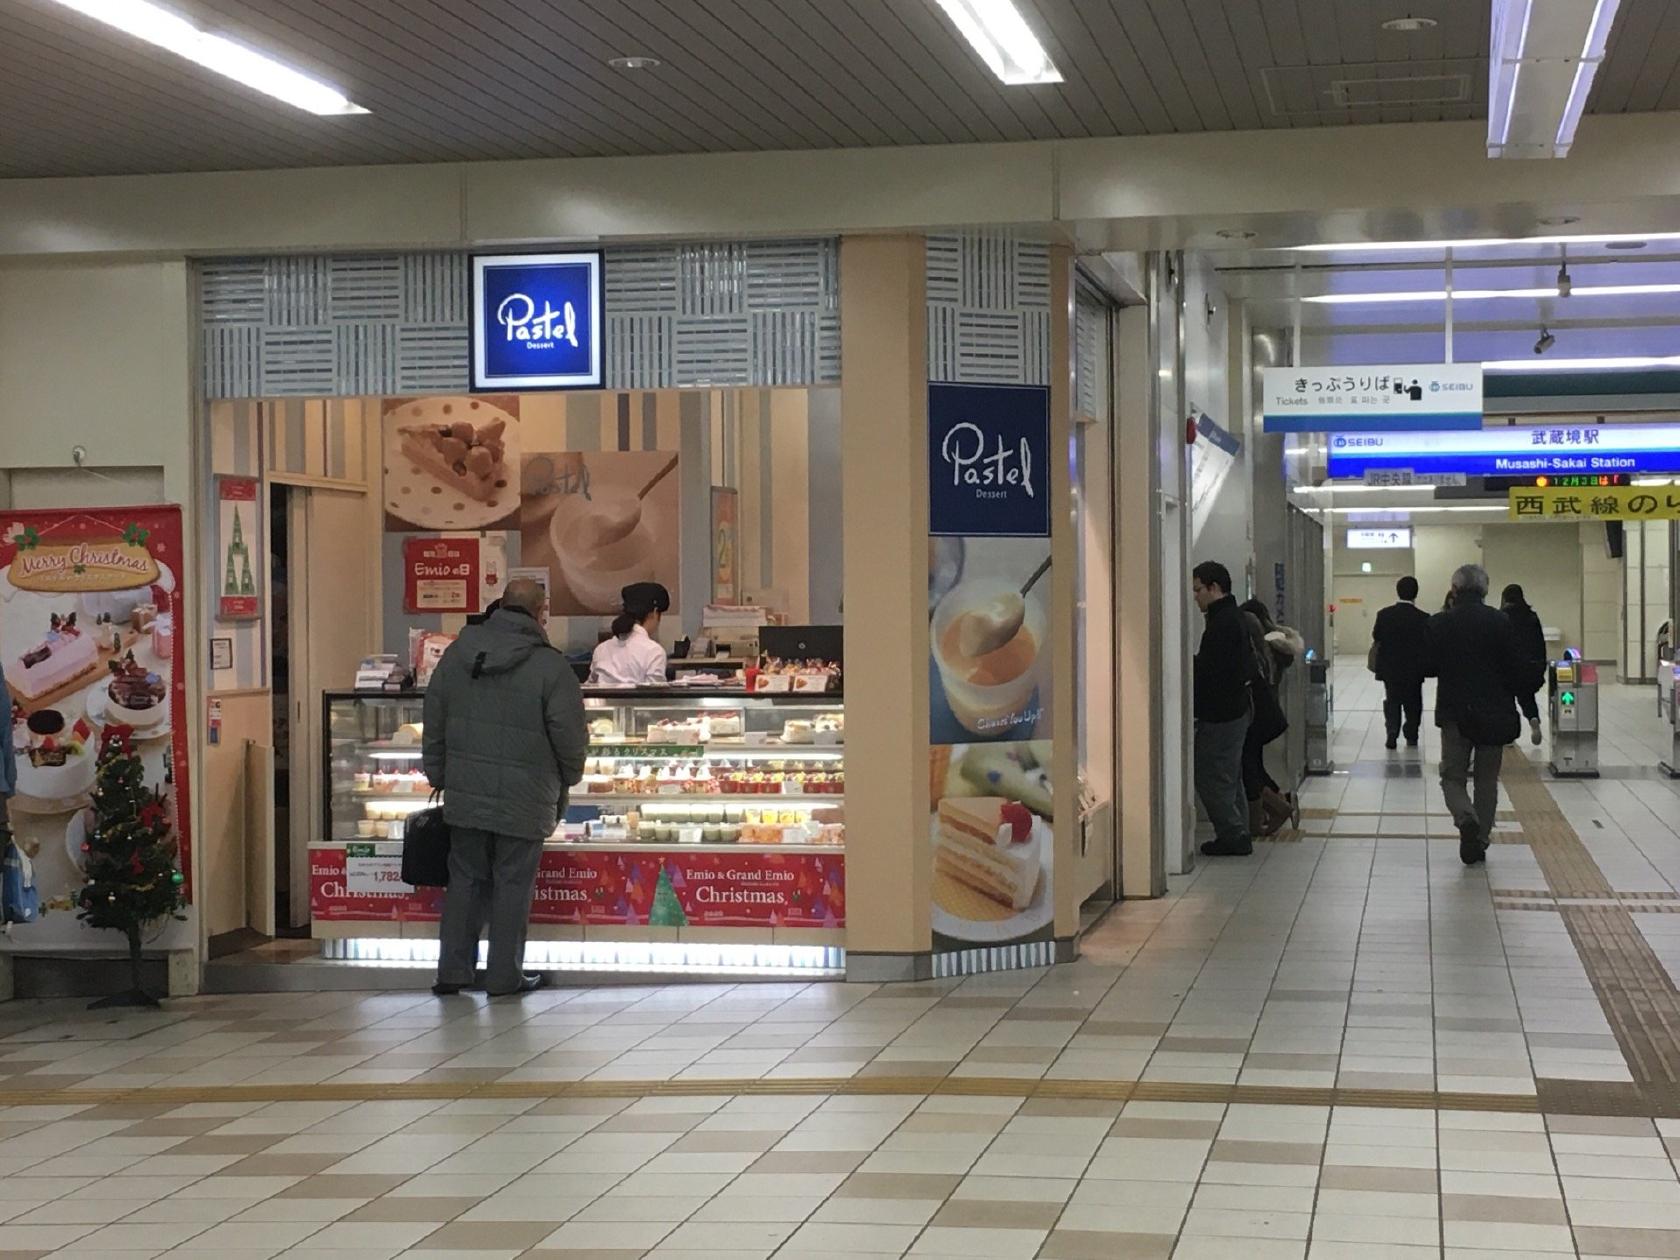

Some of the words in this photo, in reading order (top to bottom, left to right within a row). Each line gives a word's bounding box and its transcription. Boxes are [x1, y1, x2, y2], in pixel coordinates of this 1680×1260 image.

[497, 293, 579, 348] Pastel
[526, 341, 555, 350] Dessert
[1295, 376, 1390, 393] きっぷうりば
[1442, 383, 1474, 391] SEIBU
[1276, 396, 1308, 406] Tickets
[1348, 438, 1383, 447] SEIBU
[1531, 429, 1599, 445] 武蔵境駅
[942, 422, 1034, 498] Pastel
[1496, 458, 1587, 469] Musashi-Sakai
[1591, 457, 1635, 468] Station
[976, 489, 1008, 499] Dessert
[20, 554, 66, 575] Merry
[69, 543, 150, 572] Christmas
[311, 865, 340, 876] Emio
[569, 867, 598, 879] Emio
[686, 869, 716, 880] Emio
[717, 872, 725, 880] &
[726, 869, 761, 880] Grand
[765, 870, 795, 881] Emio
[534, 885, 588, 901] istmas
[695, 885, 785, 903] Christmas
